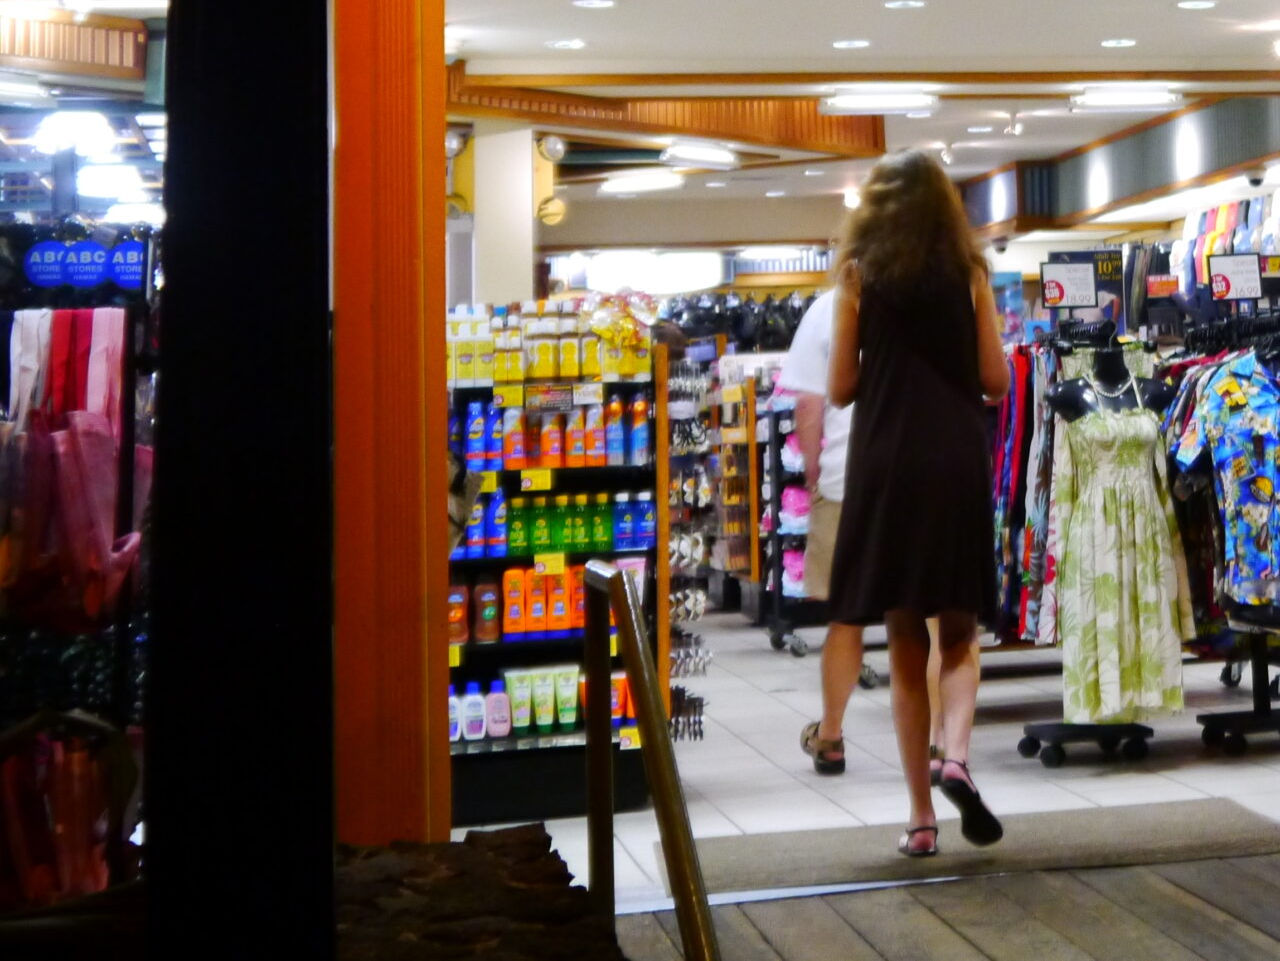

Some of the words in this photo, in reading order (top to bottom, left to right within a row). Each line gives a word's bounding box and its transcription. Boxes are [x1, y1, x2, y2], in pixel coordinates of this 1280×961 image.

[65, 251, 106, 263] ABC
[112, 251, 143, 263] AB
[1235, 287, 1258, 296] 16.99
[1066, 295, 1092, 304] 18.99
